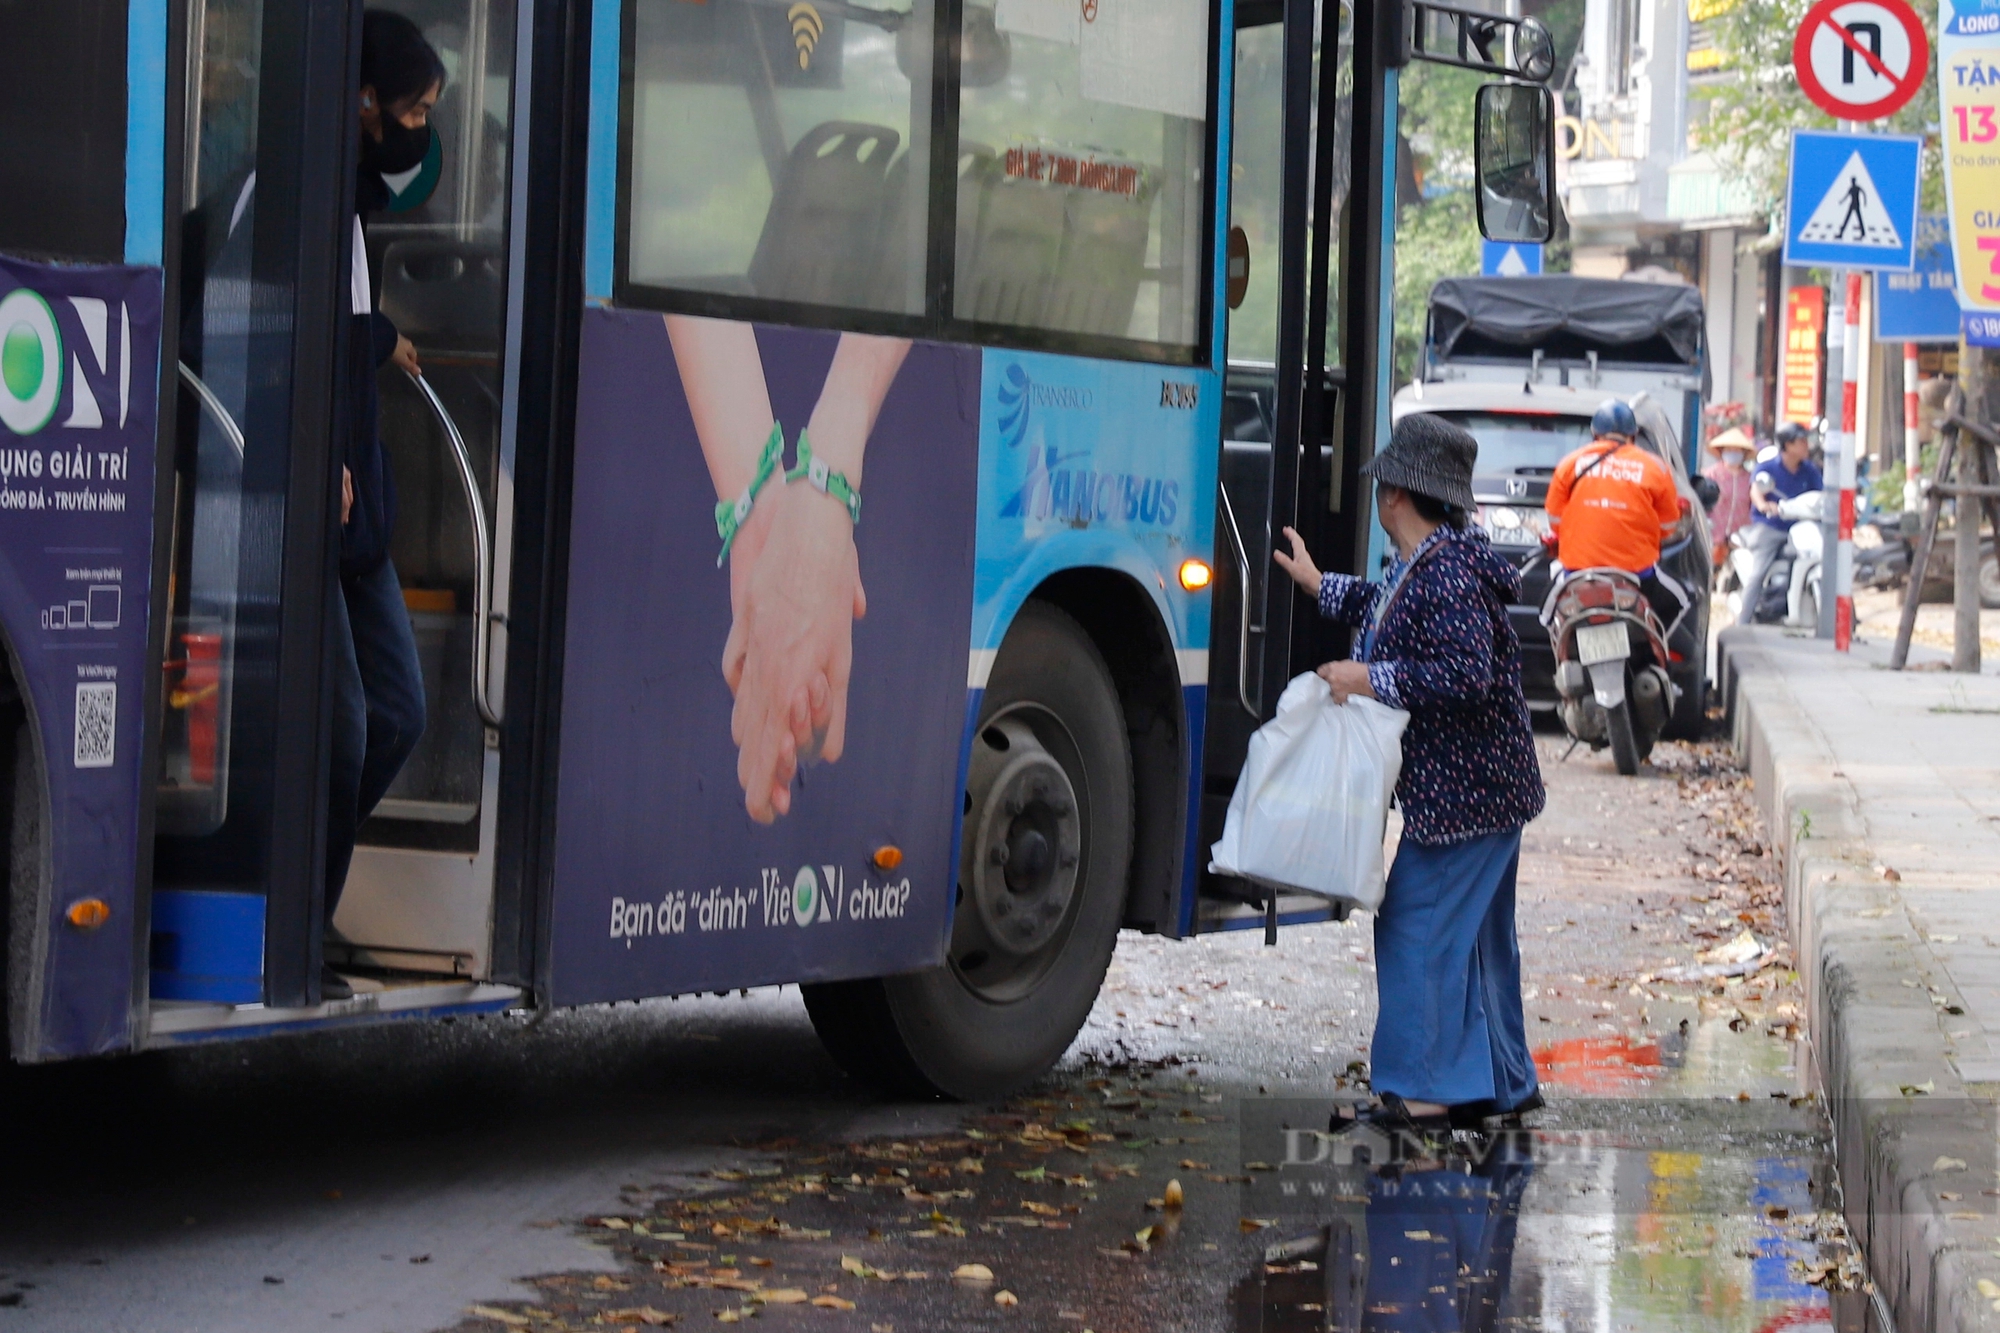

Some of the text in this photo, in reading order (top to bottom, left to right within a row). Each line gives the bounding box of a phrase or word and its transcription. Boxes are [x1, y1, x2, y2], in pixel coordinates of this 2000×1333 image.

[1953, 105, 1998, 143] 13
[50, 443, 92, 480] GIẢI
[98, 446, 129, 480] TRÍ
[1602, 464, 1644, 484] Food
[28, 486, 46, 510] ĐÁ
[99, 488, 126, 512] HÌNH
[610, 896, 653, 950] Bạn
[657, 890, 686, 935] đã
[761, 864, 844, 928] VieON
[850, 877, 911, 921] chưa?
